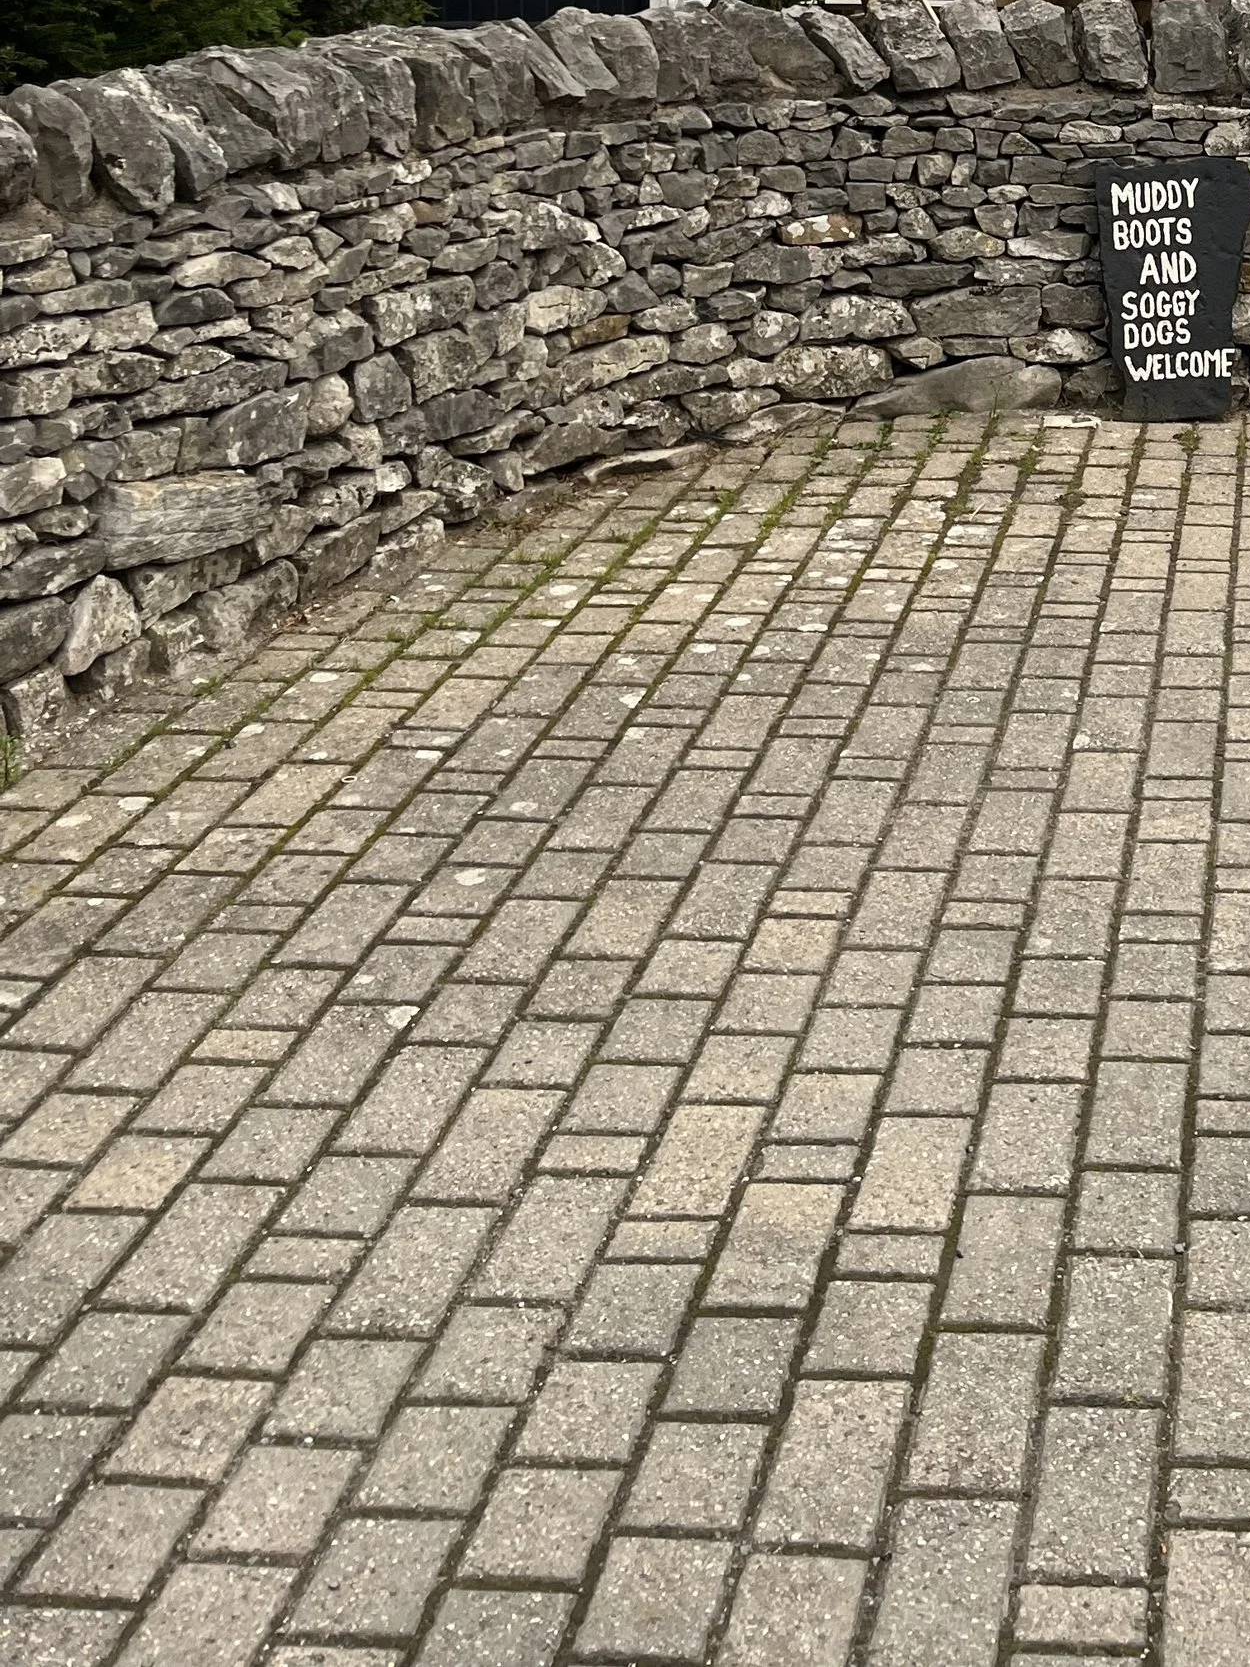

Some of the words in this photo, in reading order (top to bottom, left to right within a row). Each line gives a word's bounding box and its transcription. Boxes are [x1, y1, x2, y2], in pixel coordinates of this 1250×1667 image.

[1110, 177, 1199, 216] MUDDY
[1112, 217, 1193, 251] BOOTS
[1139, 250, 1198, 285] AND
[1121, 289, 1201, 321] SOGGY
[1123, 318, 1192, 350] DOGS
[1124, 347, 1236, 382] WELCOME
